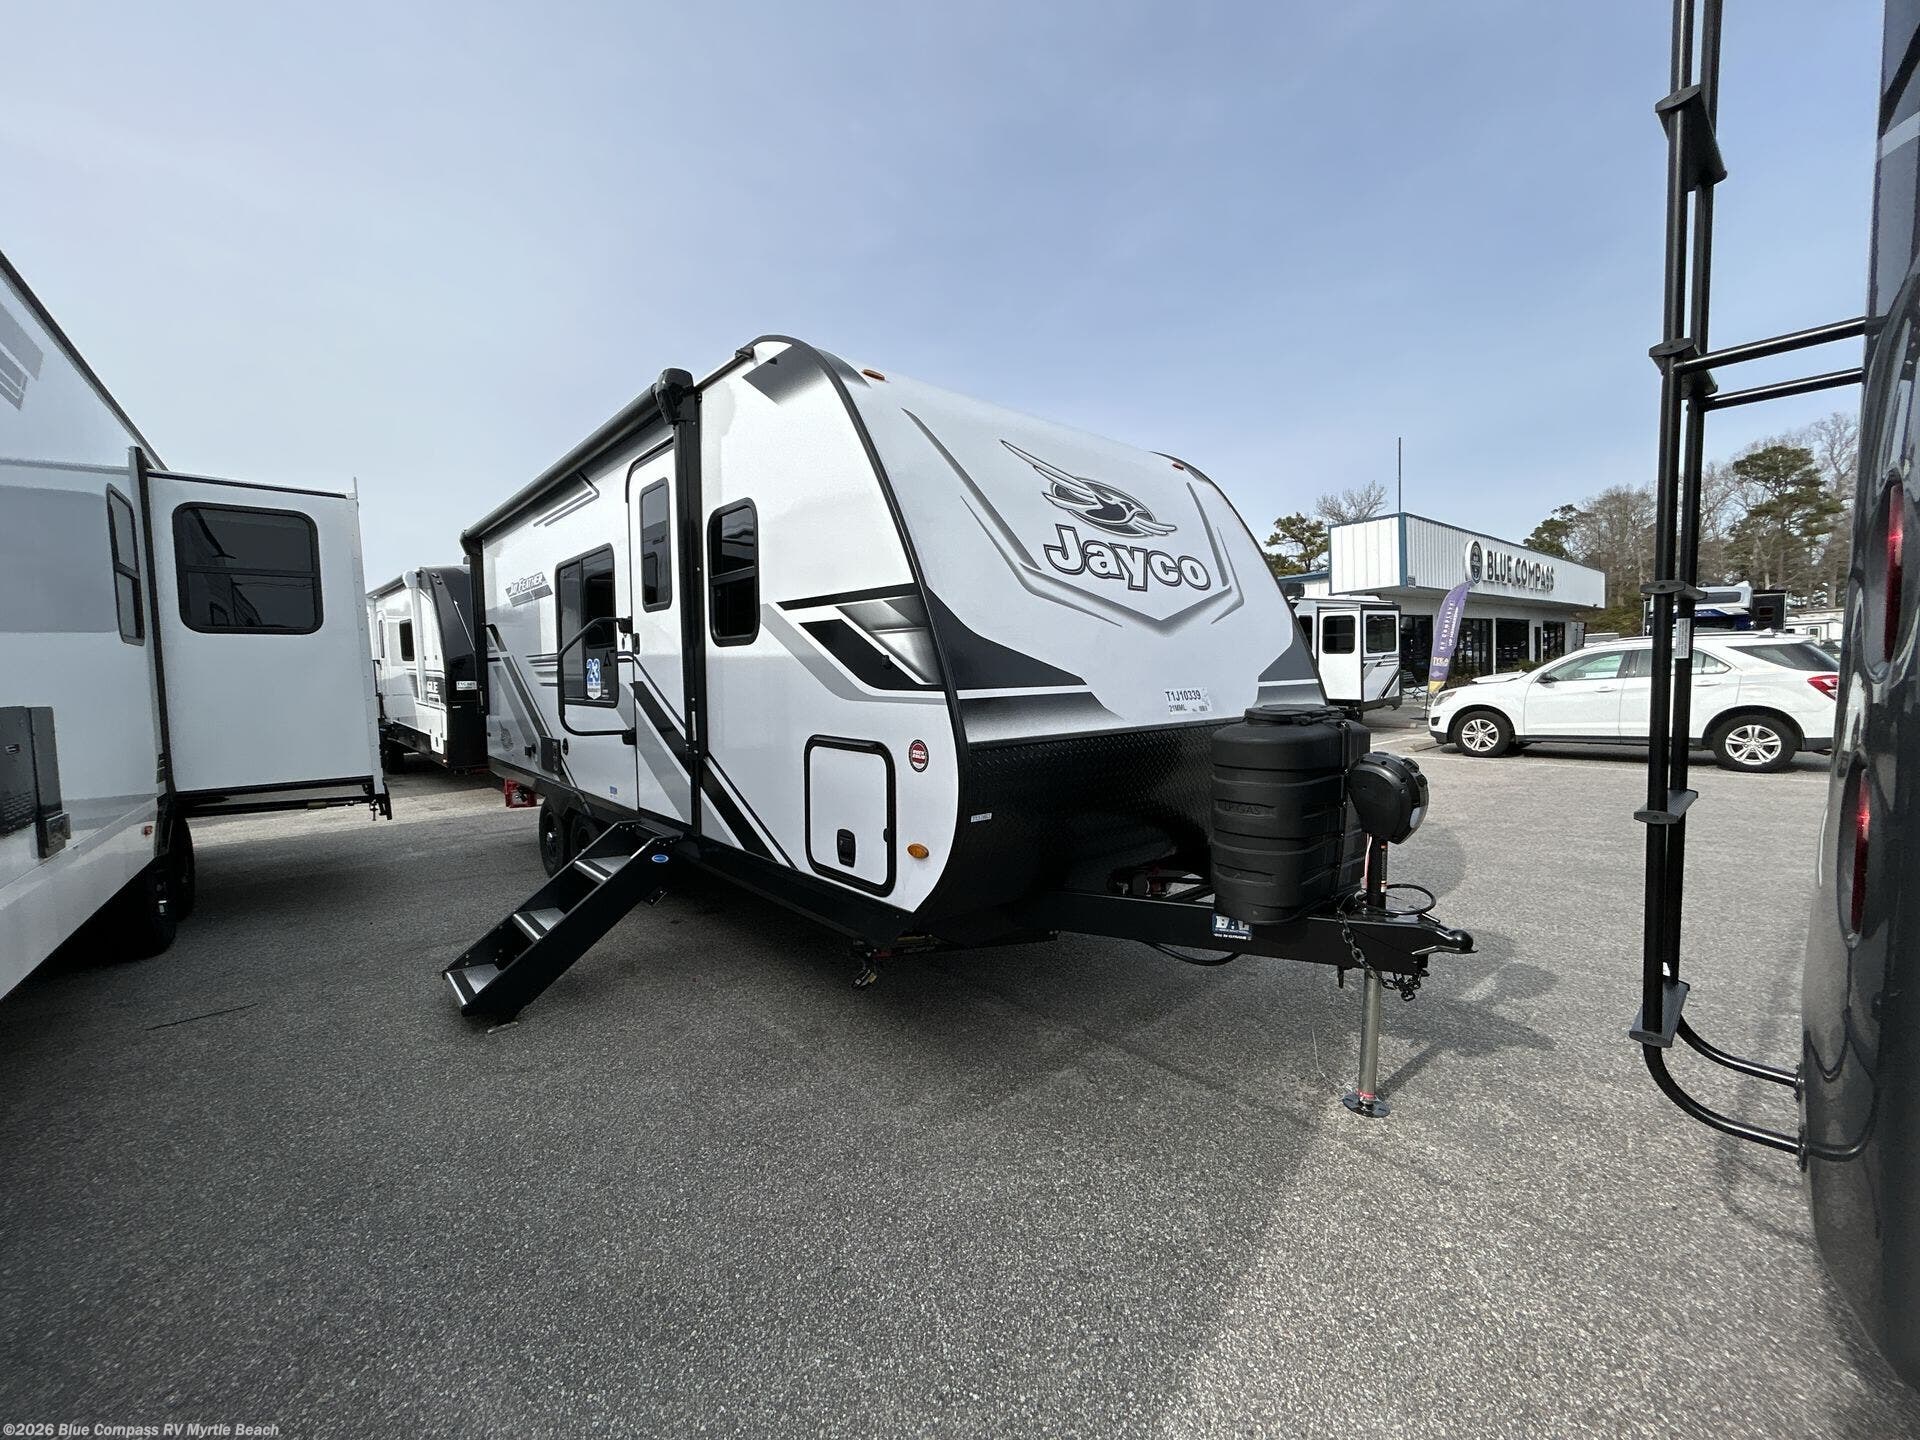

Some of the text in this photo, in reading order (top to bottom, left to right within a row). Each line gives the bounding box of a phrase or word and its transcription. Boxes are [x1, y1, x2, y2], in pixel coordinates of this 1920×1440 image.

[1043, 524, 1211, 592] Jayco
[1487, 550, 1554, 592] BLUE COMPASS
[1165, 690, 1201, 701] T1J10339
